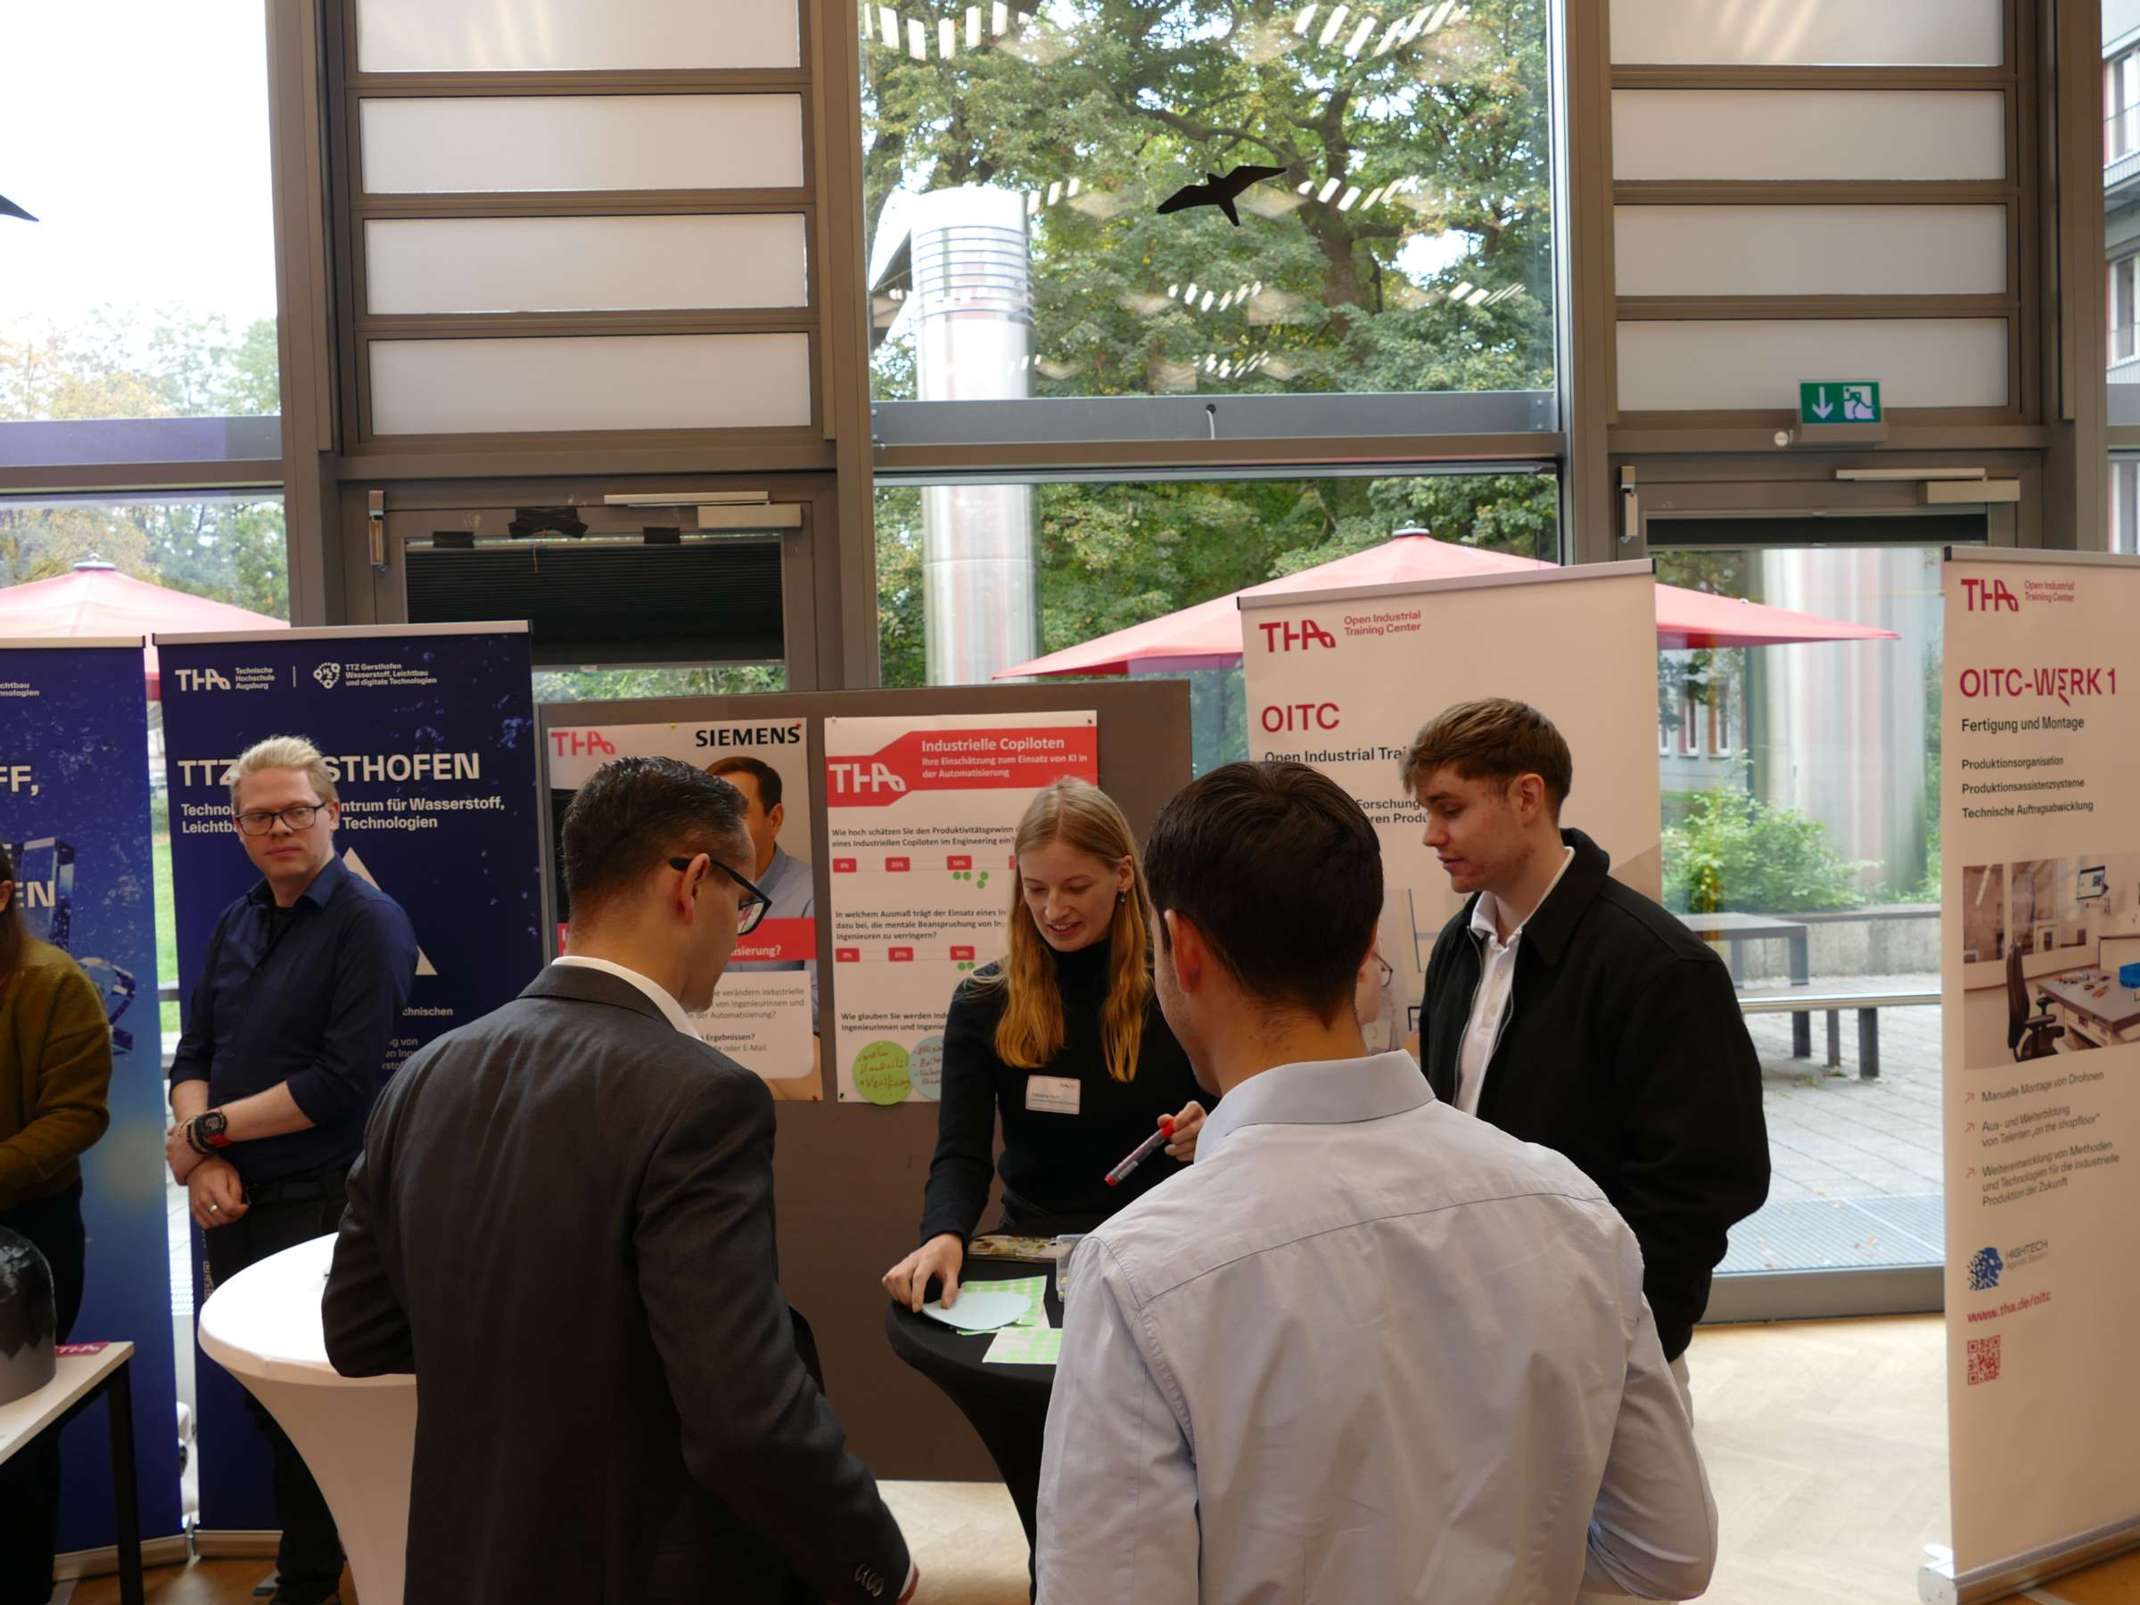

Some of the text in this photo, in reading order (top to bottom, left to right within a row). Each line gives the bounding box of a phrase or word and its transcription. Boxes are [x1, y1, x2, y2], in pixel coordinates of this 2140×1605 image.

[2024, 580, 2075, 590] Open Industrial
[2025, 591, 2074, 603] Training Center
[1344, 610, 1421, 626] Open Industrial
[1344, 622, 1421, 637] Training Center
[235, 667, 273, 675] Technische
[361, 662, 402, 671] Gersthofen
[235, 674, 275, 682] Hochschule
[345, 669, 428, 679] Wasserstoff, Leichtbau
[235, 681, 269, 690] Augsburg
[345, 676, 437, 687] und digitale Technologien
[2107, 667, 2117, 695] 1
[1261, 702, 1340, 733] OITC
[1961, 715, 2085, 734] Fertigung und Montage
[695, 726, 800, 747] SIEMENS
[921, 737, 1065, 752] Industrielle Copiloten
[922, 757, 939, 766] Ihre
[941, 756, 996, 766] Einschätzung
[998, 756, 1016, 764] zum
[1018, 754, 1048, 764] Einsatz
[1068, 754, 1077, 762] KI
[1078, 753, 1088, 762] in
[1304, 747, 1375, 763] Industrial
[323, 752, 480, 784] STHOFEN
[1961, 755, 2064, 770] Produktionsorganisation
[922, 768, 1010, 778] der Automatisierung
[1961, 779, 2085, 794] Produktionsassistenzsysteme
[386, 797, 408, 811] für
[409, 795, 505, 811] Wasserstoff,
[1961, 800, 2094, 819] Technische Auftragsabwicklung
[342, 816, 439, 832] Technologien
[848, 828, 866, 836] hoch
[868, 827, 901, 836] schätzen
[902, 827, 914, 835] Sie
[916, 827, 930, 835] den
[932, 825, 1014, 836] Produktivitätsgewinn
[853, 839, 901, 847] Industriellen
[902, 838, 939, 848] Copiloten
[940, 838, 951, 846] im
[952, 837, 998, 847] Engineering
[999, 836, 1016, 845] ein?
[845, 910, 879, 918] welchem
[913, 910, 932, 919] trägt
[933, 909, 946, 917] der
[948, 909, 974, 917] Einsatz
[855, 921, 868, 930] bei,
[871, 921, 883, 929] die
[918, 920, 976, 929] Beanspruchung
[978, 920, 992, 928] von
[836, 932, 881, 941] Ingenieuren
[894, 931, 937, 941] verringern?
[841, 1012, 857, 1020] Wie
[858, 1012, 889, 1021] glauben
[890, 1011, 901, 1019] Sie
[903, 1011, 932, 1019] werden
[841, 1024, 899, 1033] Ingenieurinnen
[900, 1023, 916, 1031] und
